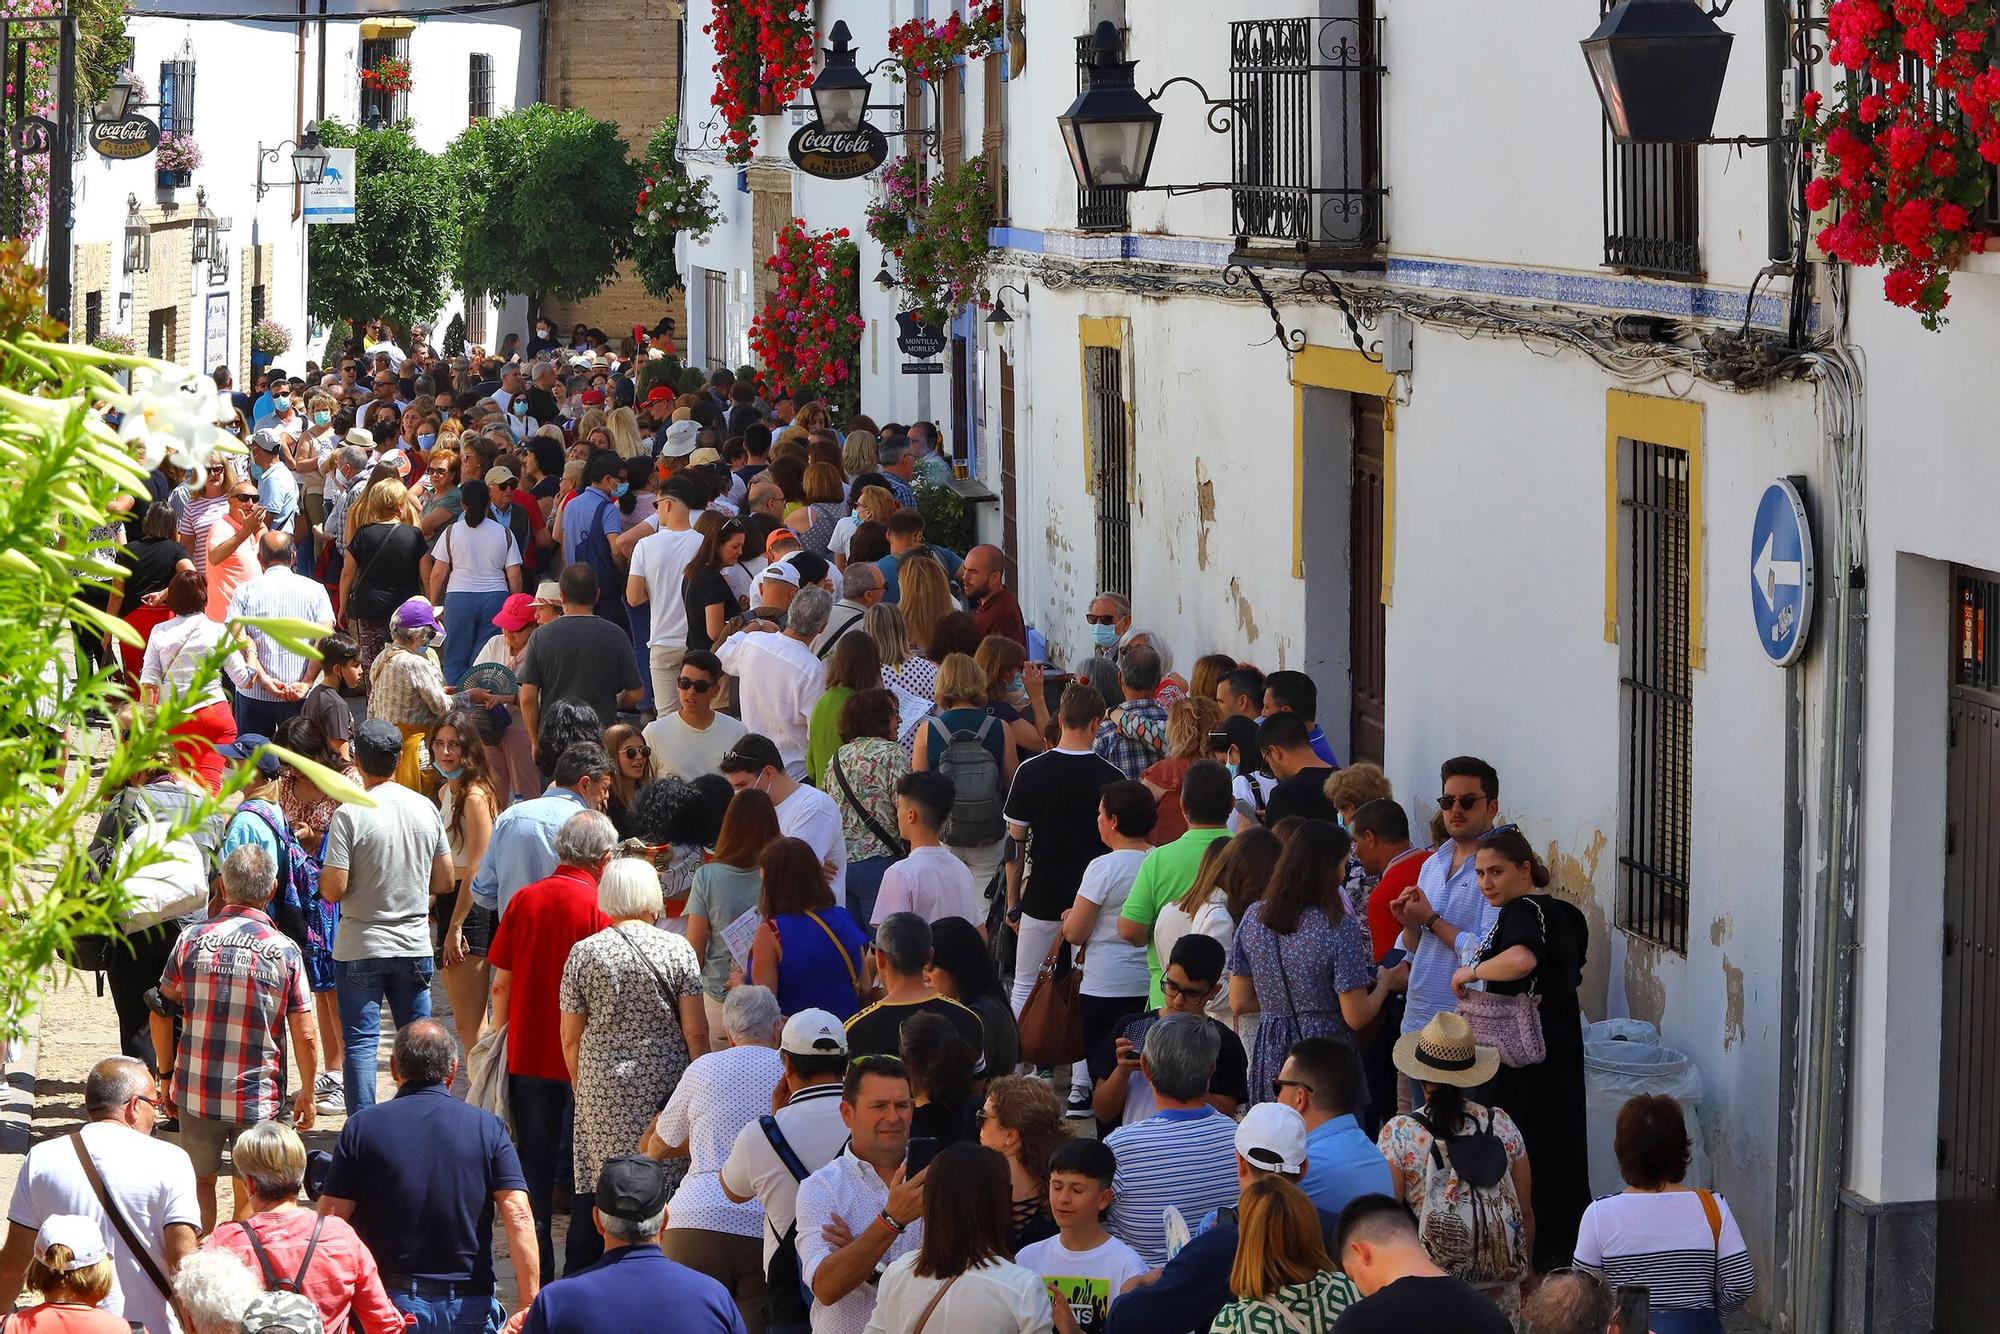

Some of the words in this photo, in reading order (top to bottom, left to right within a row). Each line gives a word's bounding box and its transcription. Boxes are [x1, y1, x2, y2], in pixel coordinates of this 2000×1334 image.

[809, 162, 828, 173] SAN
[832, 161, 871, 174] BASILIO
[216, 952, 234, 964] NEW
[236, 954, 257, 968] YORK
[193, 961, 236, 976] PREMIUM
